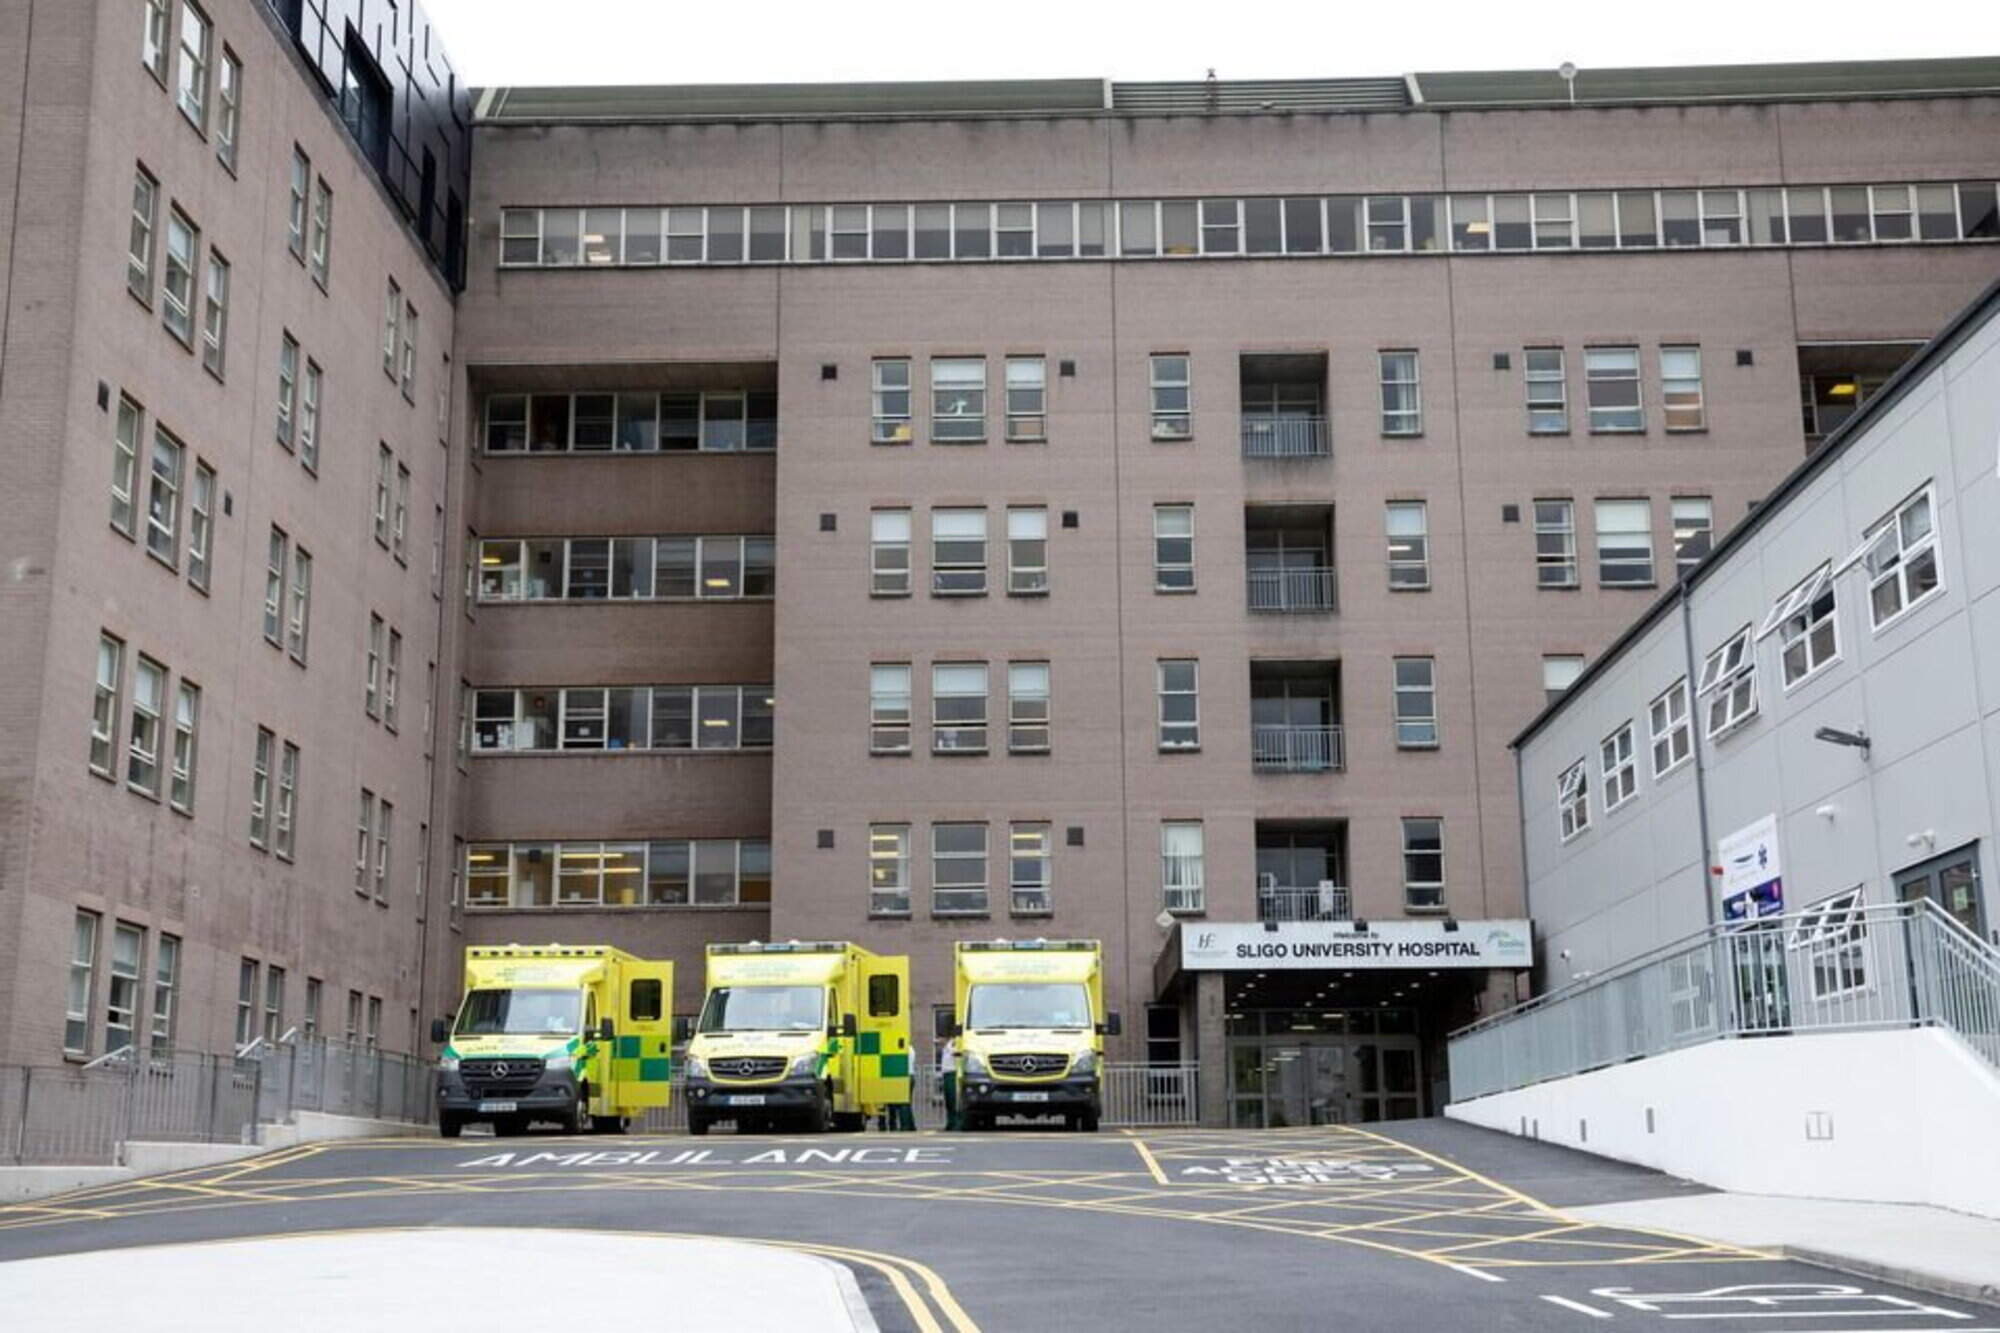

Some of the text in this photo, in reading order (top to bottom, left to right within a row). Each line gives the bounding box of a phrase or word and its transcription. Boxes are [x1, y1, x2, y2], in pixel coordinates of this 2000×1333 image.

[1236, 943, 1288, 959] SLIGO
[1293, 942, 1393, 957] UNIVERSITY
[1398, 941, 1480, 956] HOSPITAL
[456, 1147, 955, 1167] AMBULANCE
